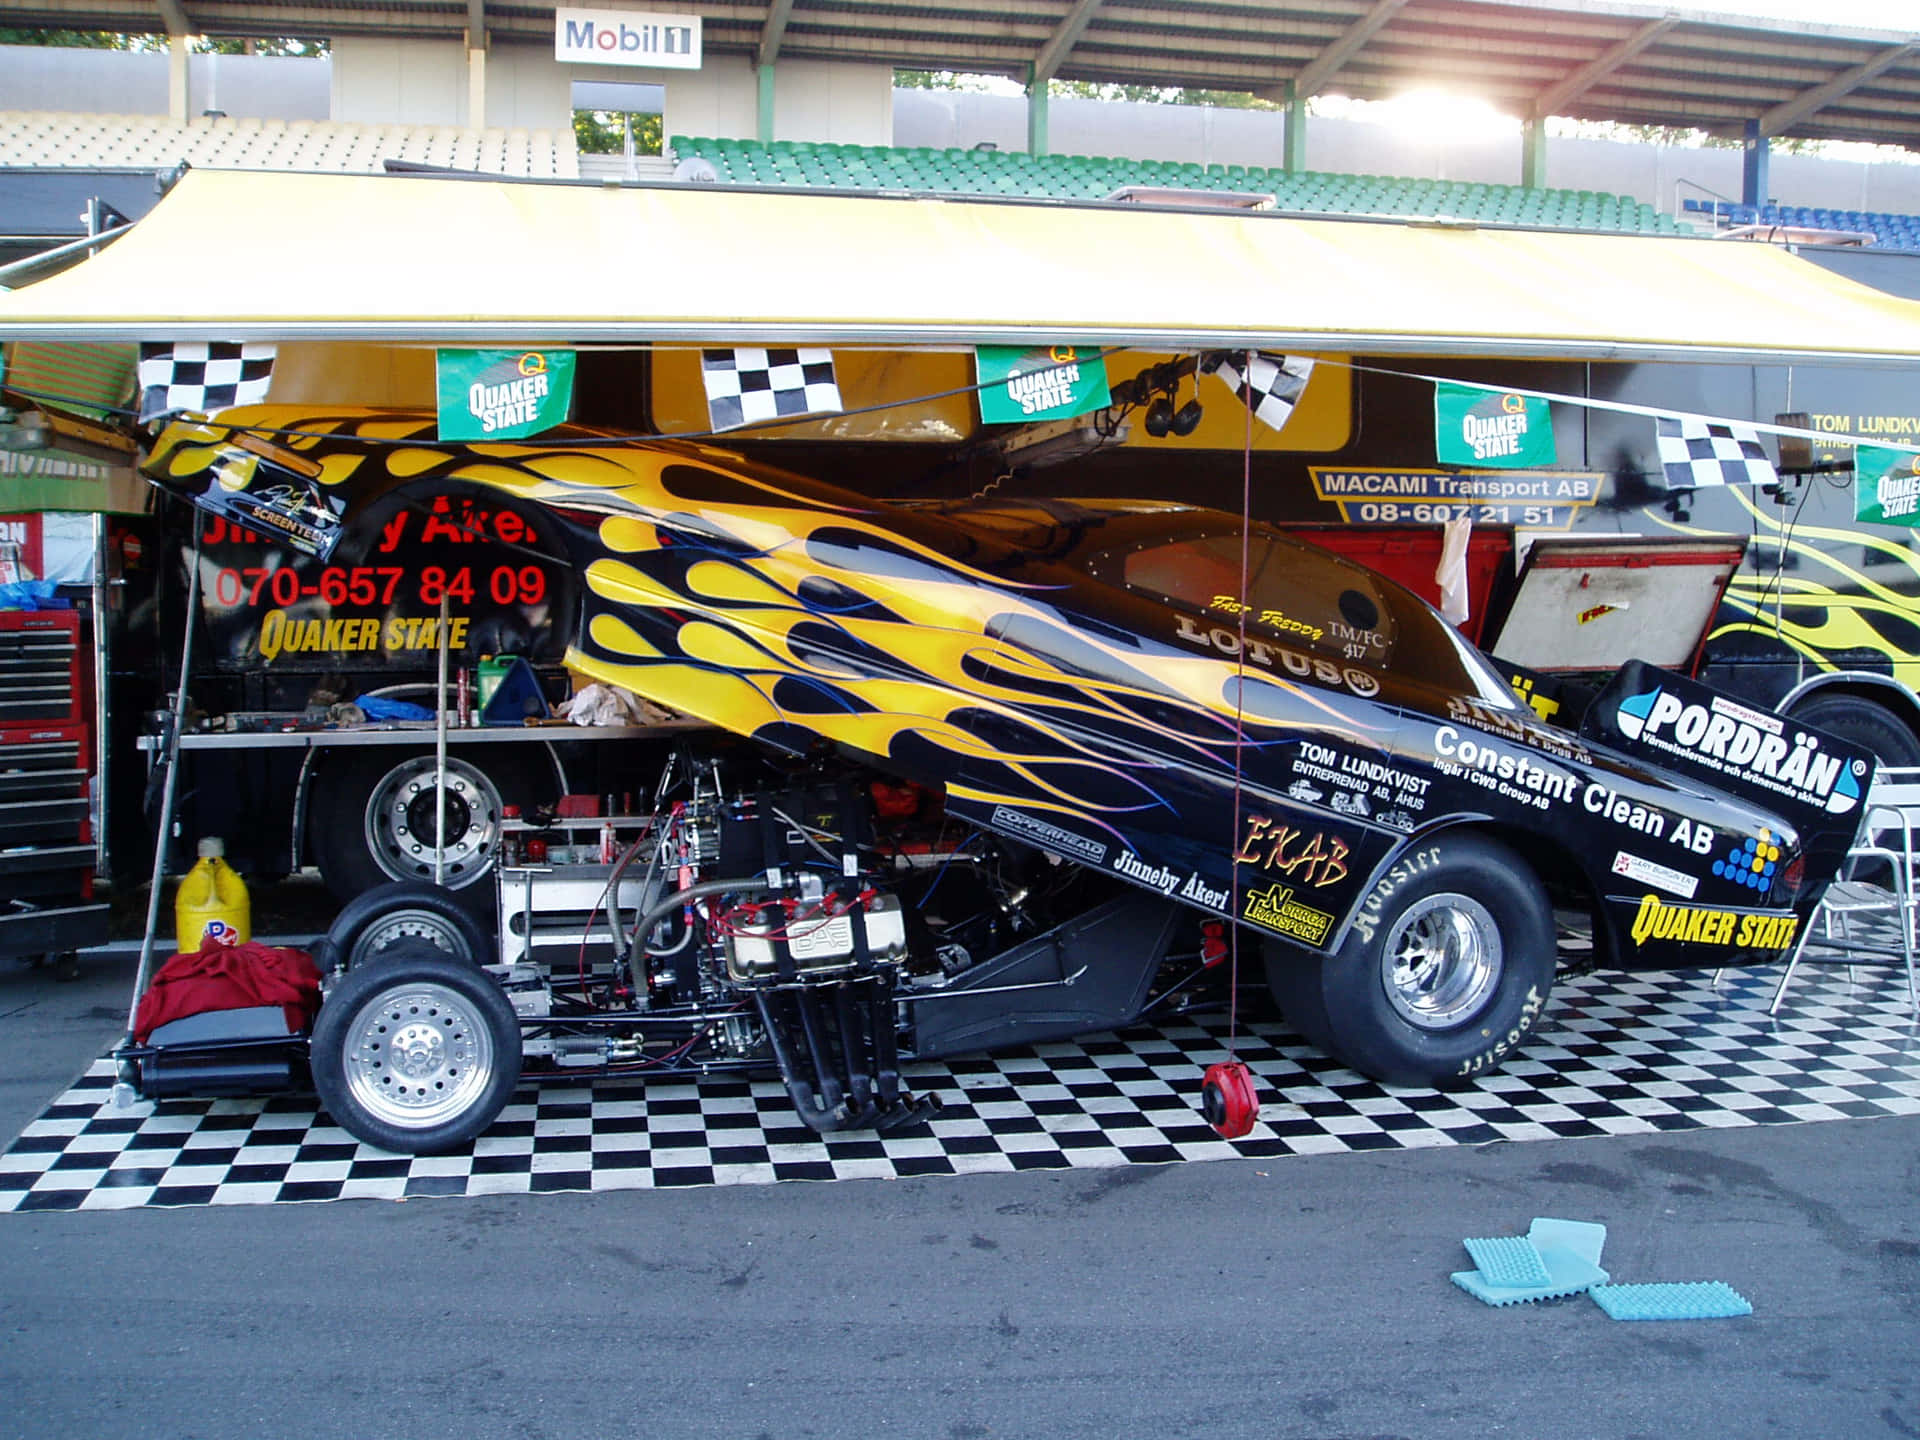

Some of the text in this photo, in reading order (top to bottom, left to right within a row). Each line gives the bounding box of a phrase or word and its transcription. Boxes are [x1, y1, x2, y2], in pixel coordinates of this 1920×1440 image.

[566, 20, 657, 53] Mobil
[469, 374, 548, 419] QUAKER
[1007, 364, 1080, 402] QUAKER
[482, 398, 538, 432] STATE
[1463, 414, 1527, 447] QUAKER
[1813, 414, 1850, 432] TOM
[1325, 474, 1590, 500] MACAMI Transport AB
[1360, 503, 1554, 524] 08-607 21 51
[216, 566, 546, 607] 070-657 84 09
[259, 609, 380, 662] QUAKER
[1210, 595, 1324, 640] FAST FREDDY
[1328, 621, 1384, 648] TM/FC
[1174, 614, 1342, 685] LOTUS
[1642, 731, 1722, 770] Värmeisolerande
[1723, 764, 1740, 777] och
[1742, 769, 1796, 797] dränerande
[1644, 691, 1842, 796] PORDRÄN
[1292, 760, 1424, 810] ENTREPRENAD AB, ÅHUS
[1300, 741, 1431, 795] TOM LUNDKVIST
[1433, 757, 1463, 776] Ingår
[1498, 782, 1531, 804] Group
[1532, 796, 1550, 810] AB
[1434, 726, 1714, 855] Constant Clean AB
[1113, 849, 1230, 910] Jinneby Åkeri
[1631, 894, 1737, 946] QUAKER
